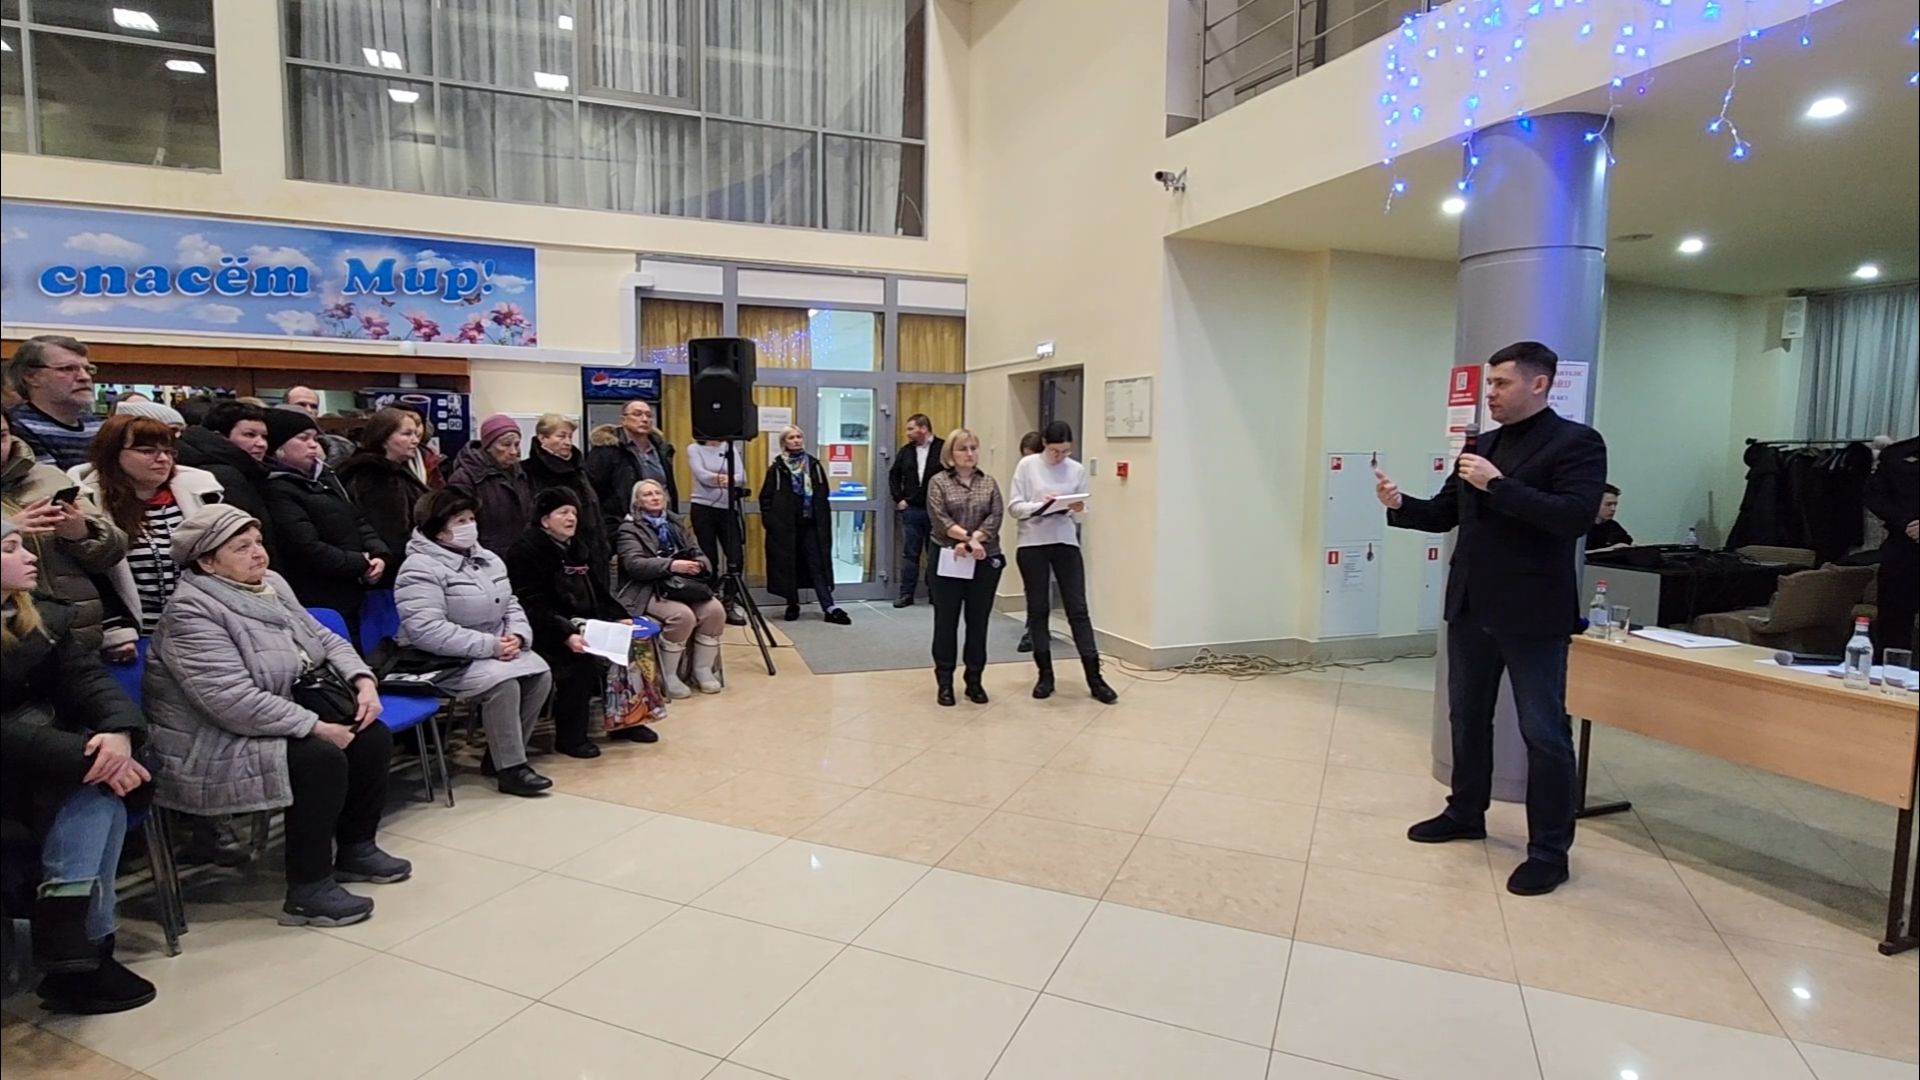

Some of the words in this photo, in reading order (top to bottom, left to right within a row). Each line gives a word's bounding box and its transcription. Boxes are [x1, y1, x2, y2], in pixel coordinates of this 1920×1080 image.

[39, 256, 310, 296] спасём
[342, 257, 497, 303] Мир!
[608, 378, 654, 388] PEPSI
